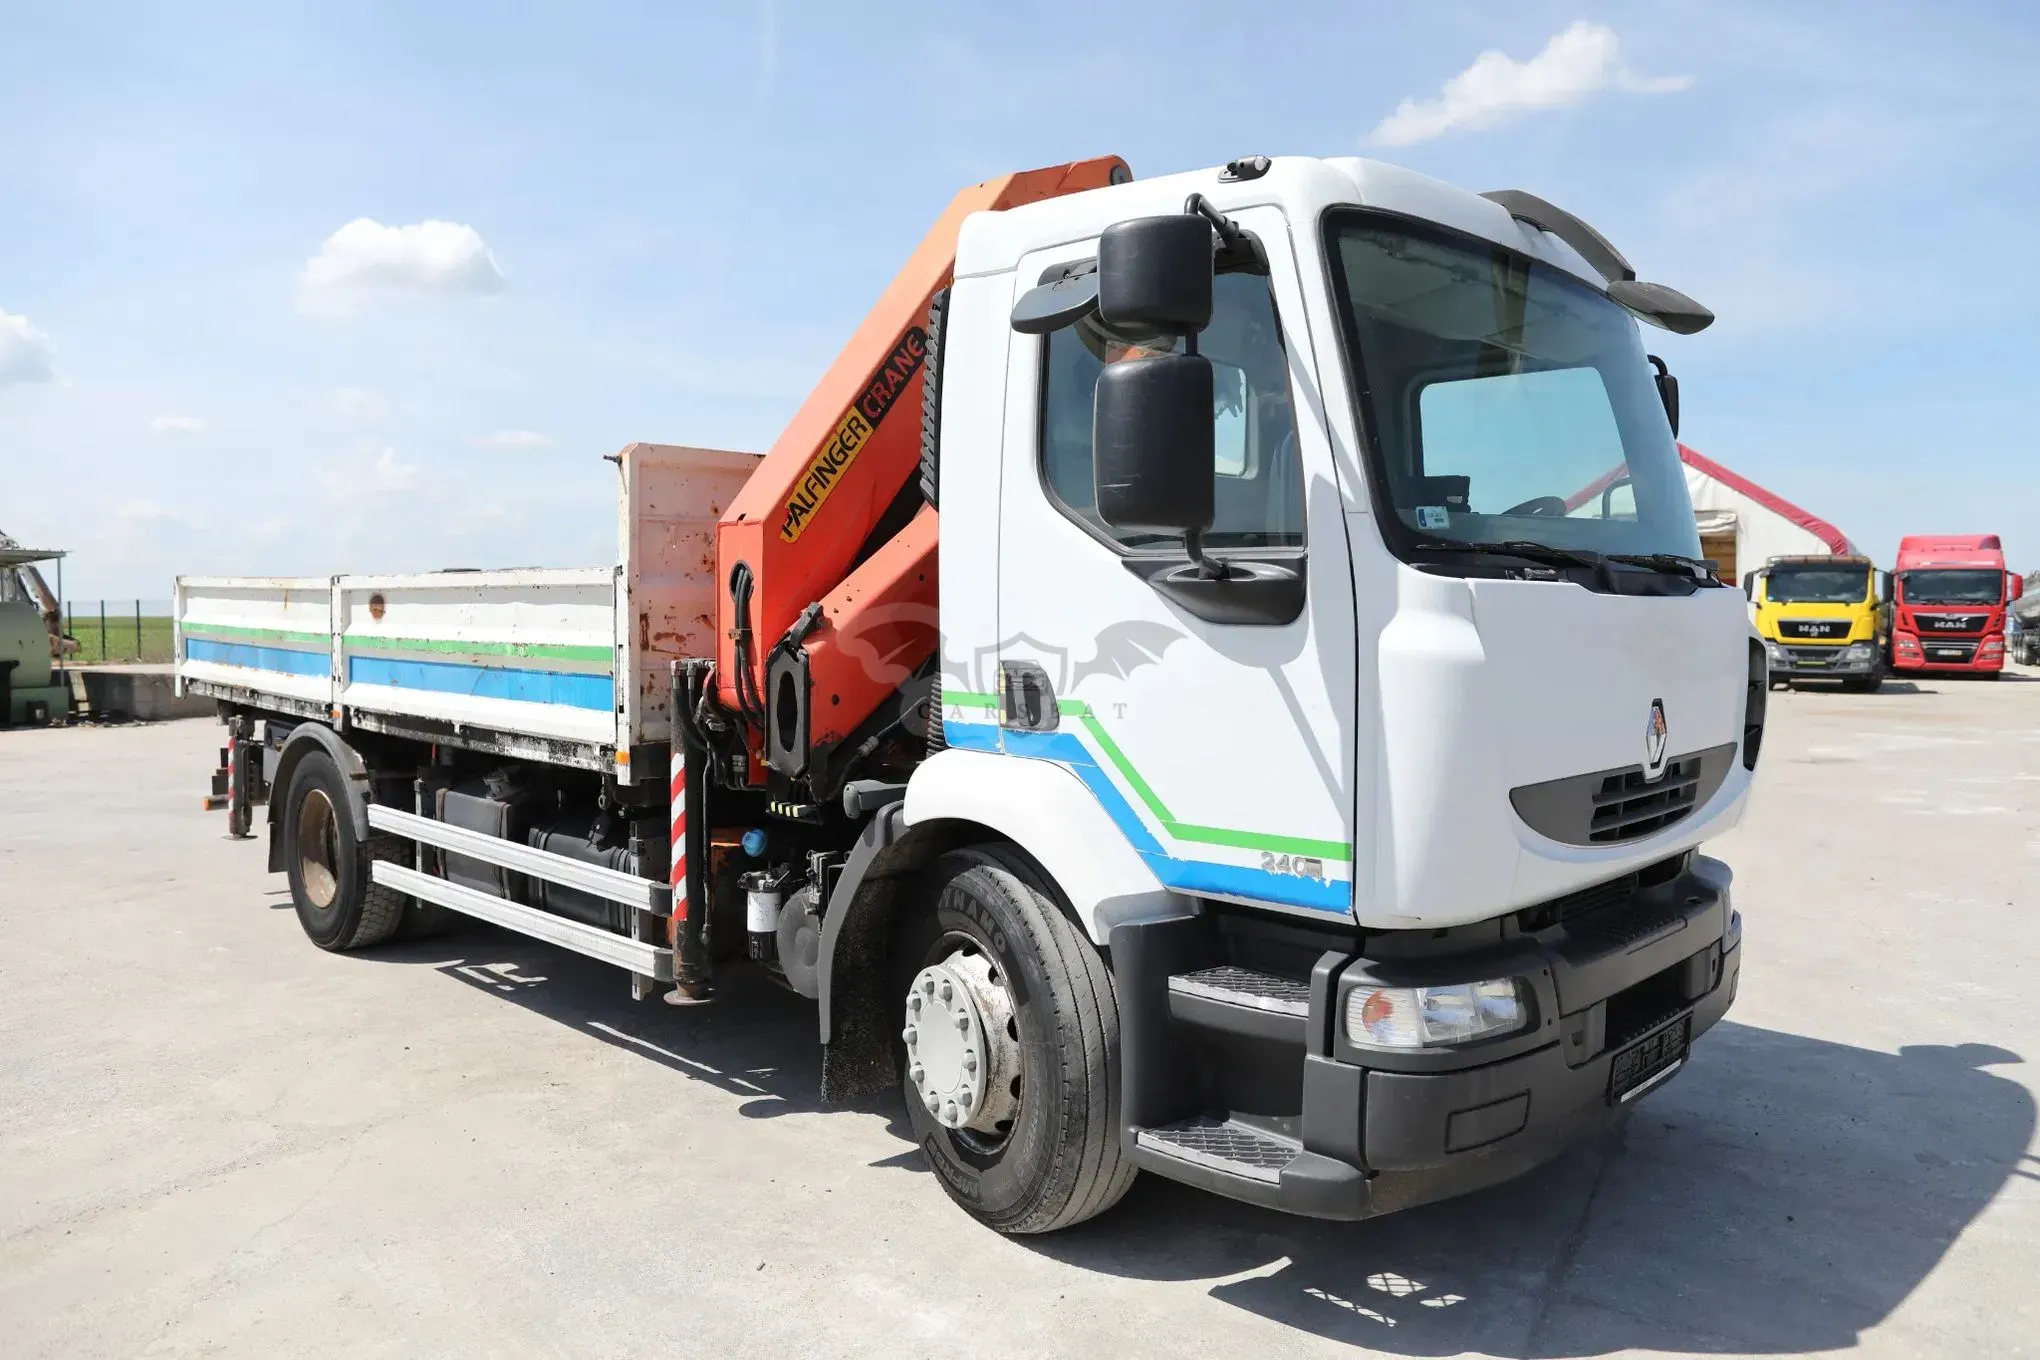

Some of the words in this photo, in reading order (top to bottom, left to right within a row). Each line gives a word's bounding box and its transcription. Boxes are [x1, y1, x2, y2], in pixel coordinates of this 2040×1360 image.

[781, 415, 868, 538] PALFINGER
[861, 334, 925, 418] CRANE
[1934, 621, 1967, 629] MAN
